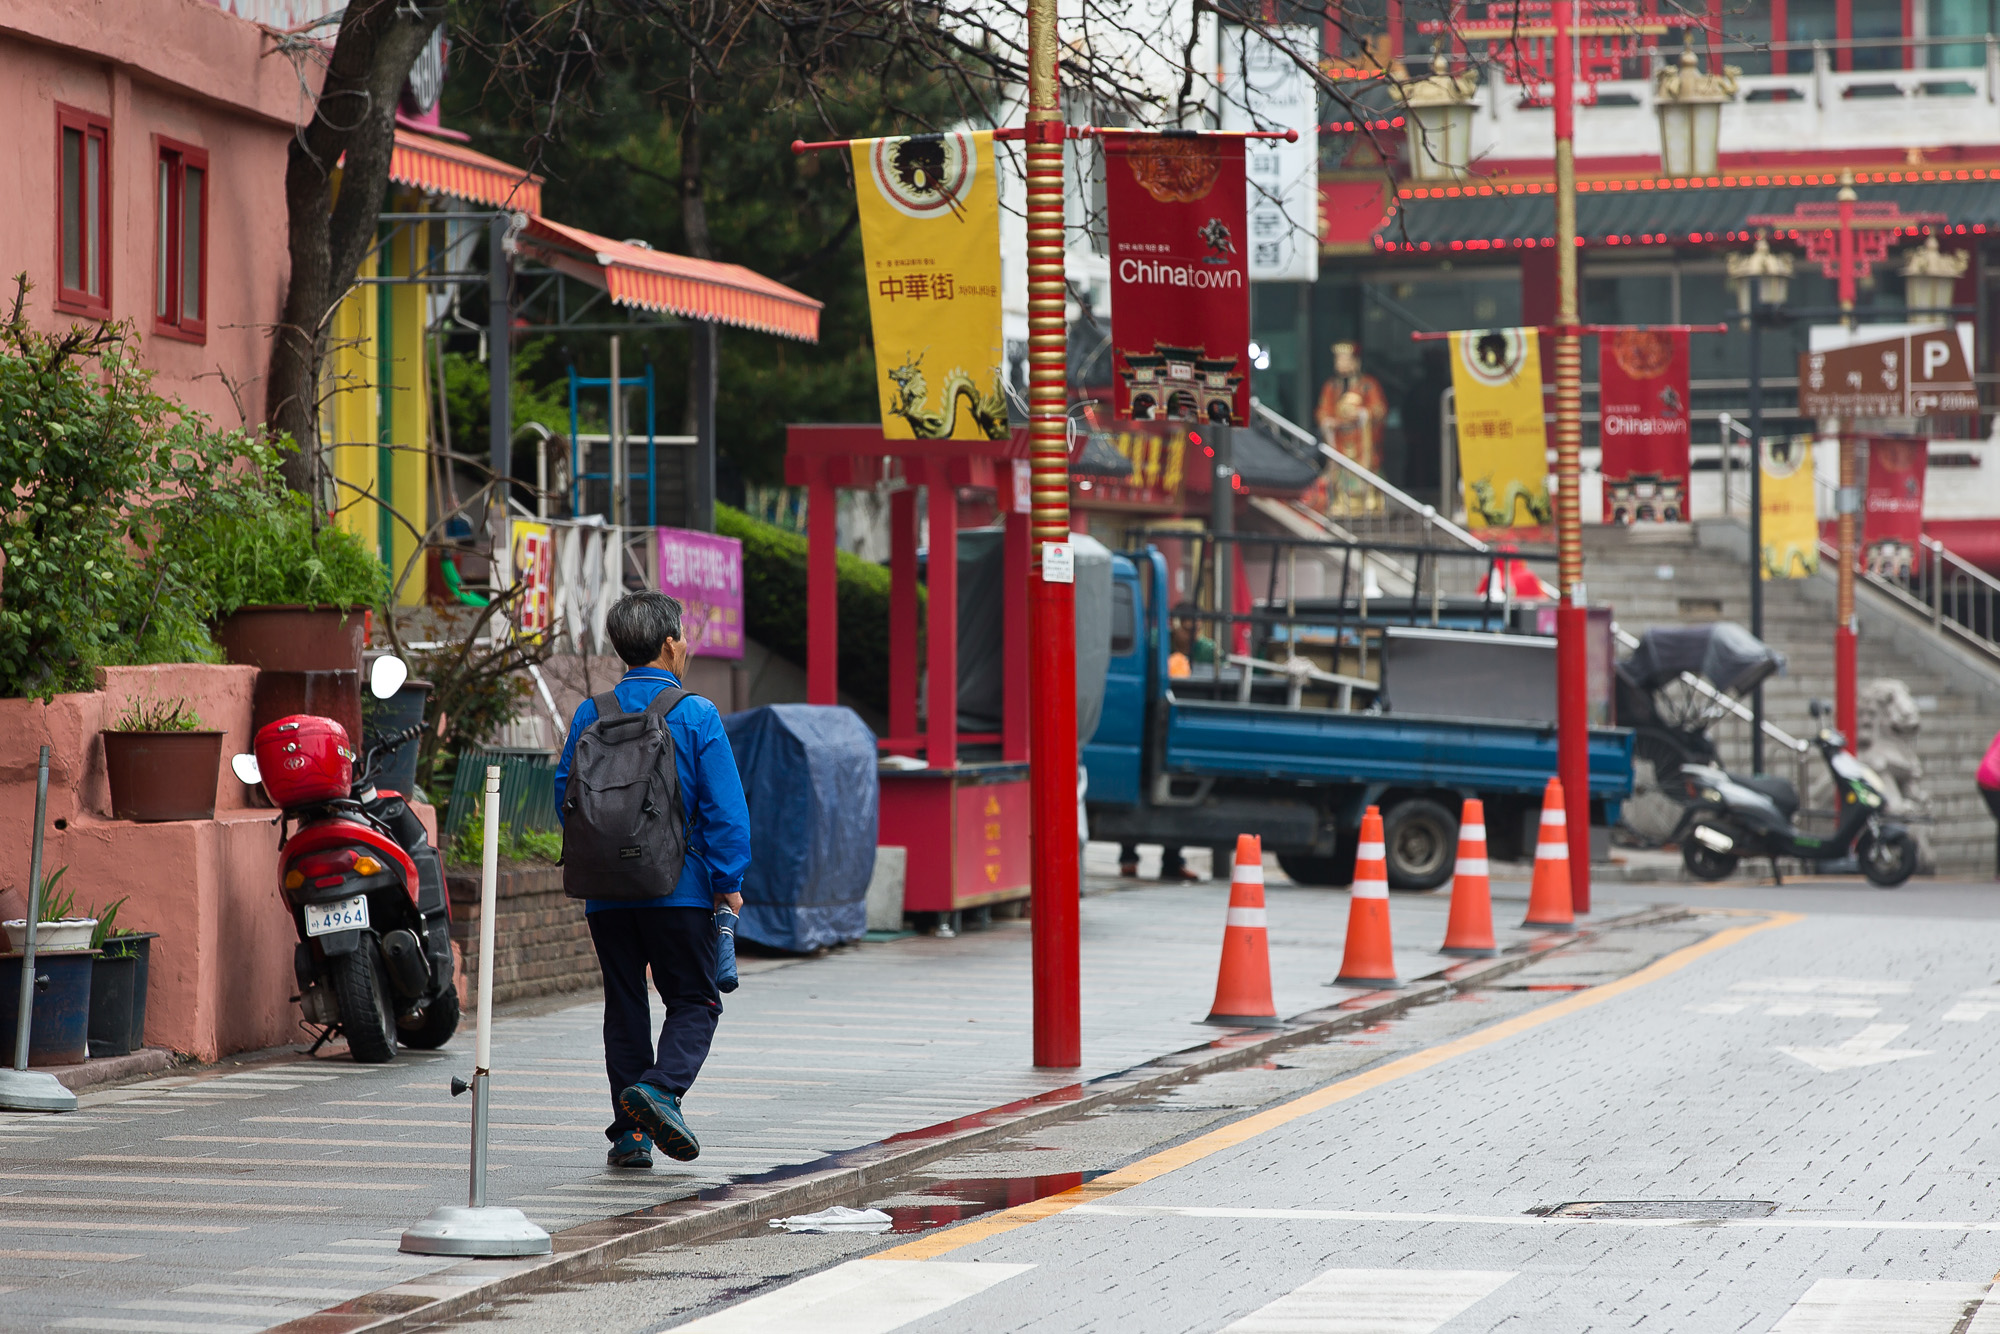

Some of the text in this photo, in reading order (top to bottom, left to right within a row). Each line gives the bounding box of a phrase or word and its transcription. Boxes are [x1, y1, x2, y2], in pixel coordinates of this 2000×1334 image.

[879, 273, 955, 302] 中華街
[1119, 259, 1242, 288] Chinatown
[1923, 340, 1950, 380] P
[1604, 414, 1686, 436] Chinatown
[324, 910, 362, 927] 4964
